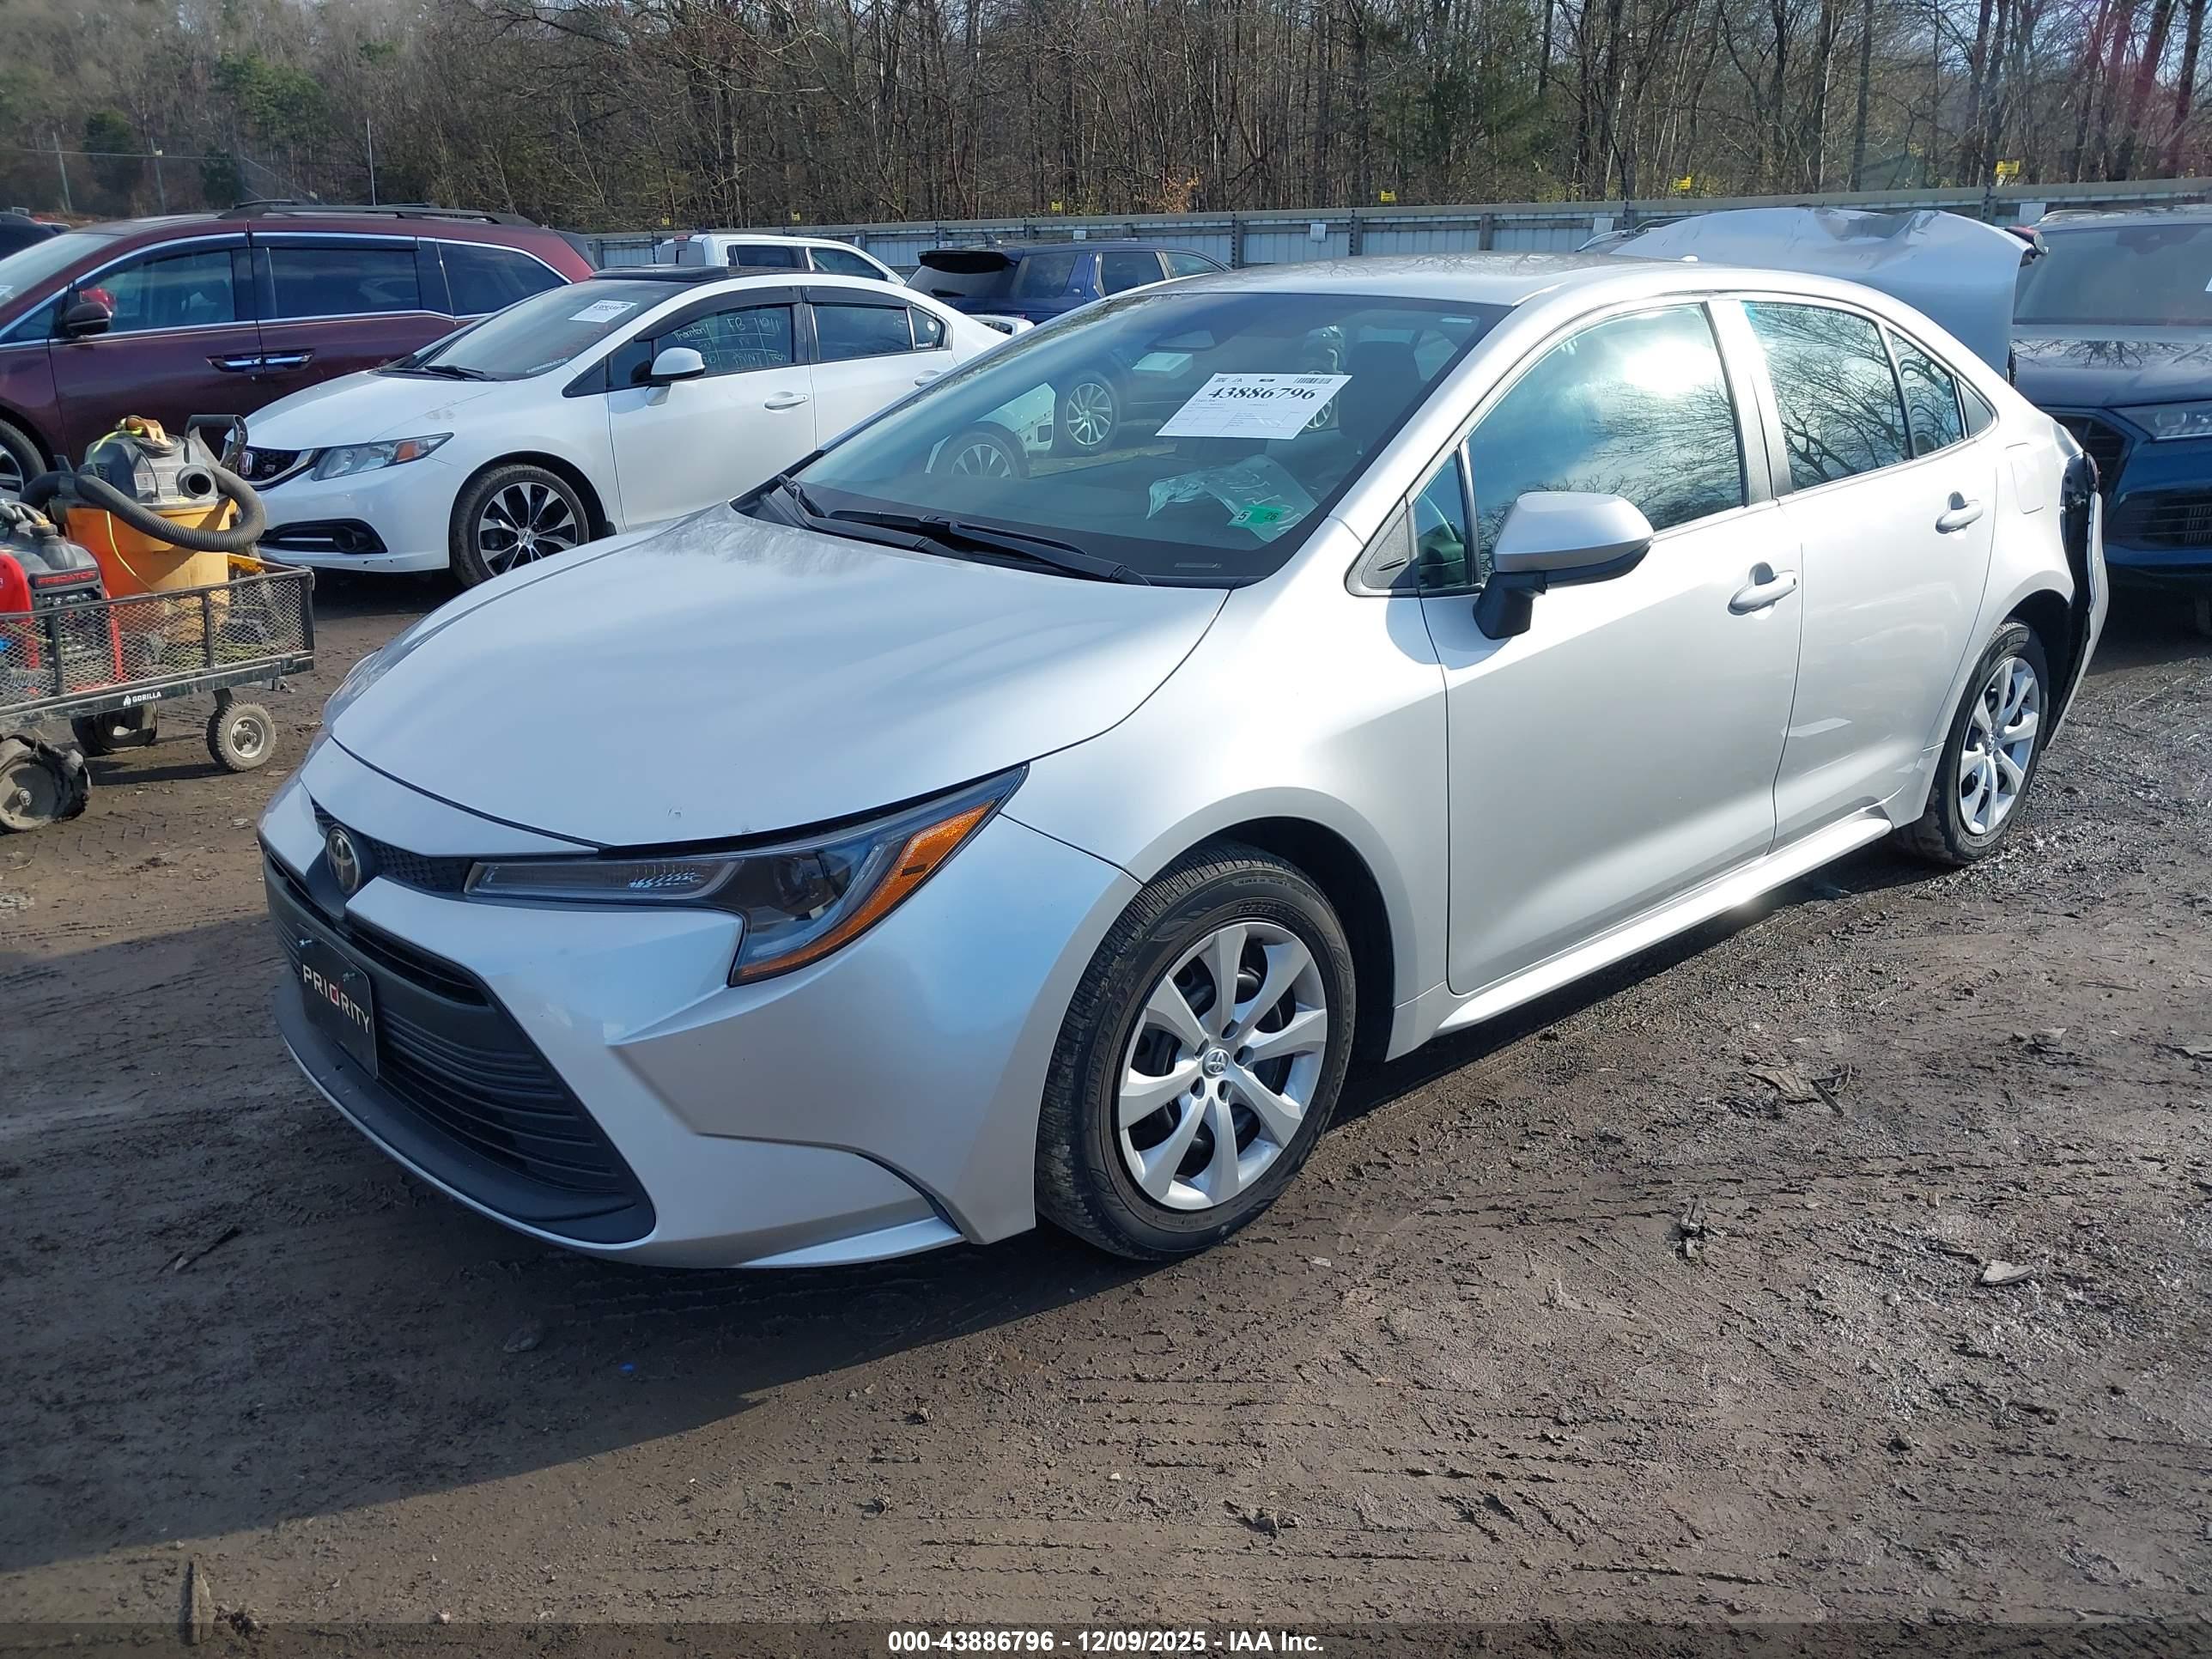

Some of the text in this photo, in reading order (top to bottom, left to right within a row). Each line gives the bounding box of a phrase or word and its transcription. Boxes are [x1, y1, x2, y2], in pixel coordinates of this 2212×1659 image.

[1208, 386, 1321, 400] 43886796
[1238, 511, 1249, 520] 5
[132, 691, 161, 702] GORILLA
[302, 963, 370, 1034] PRIORITY
